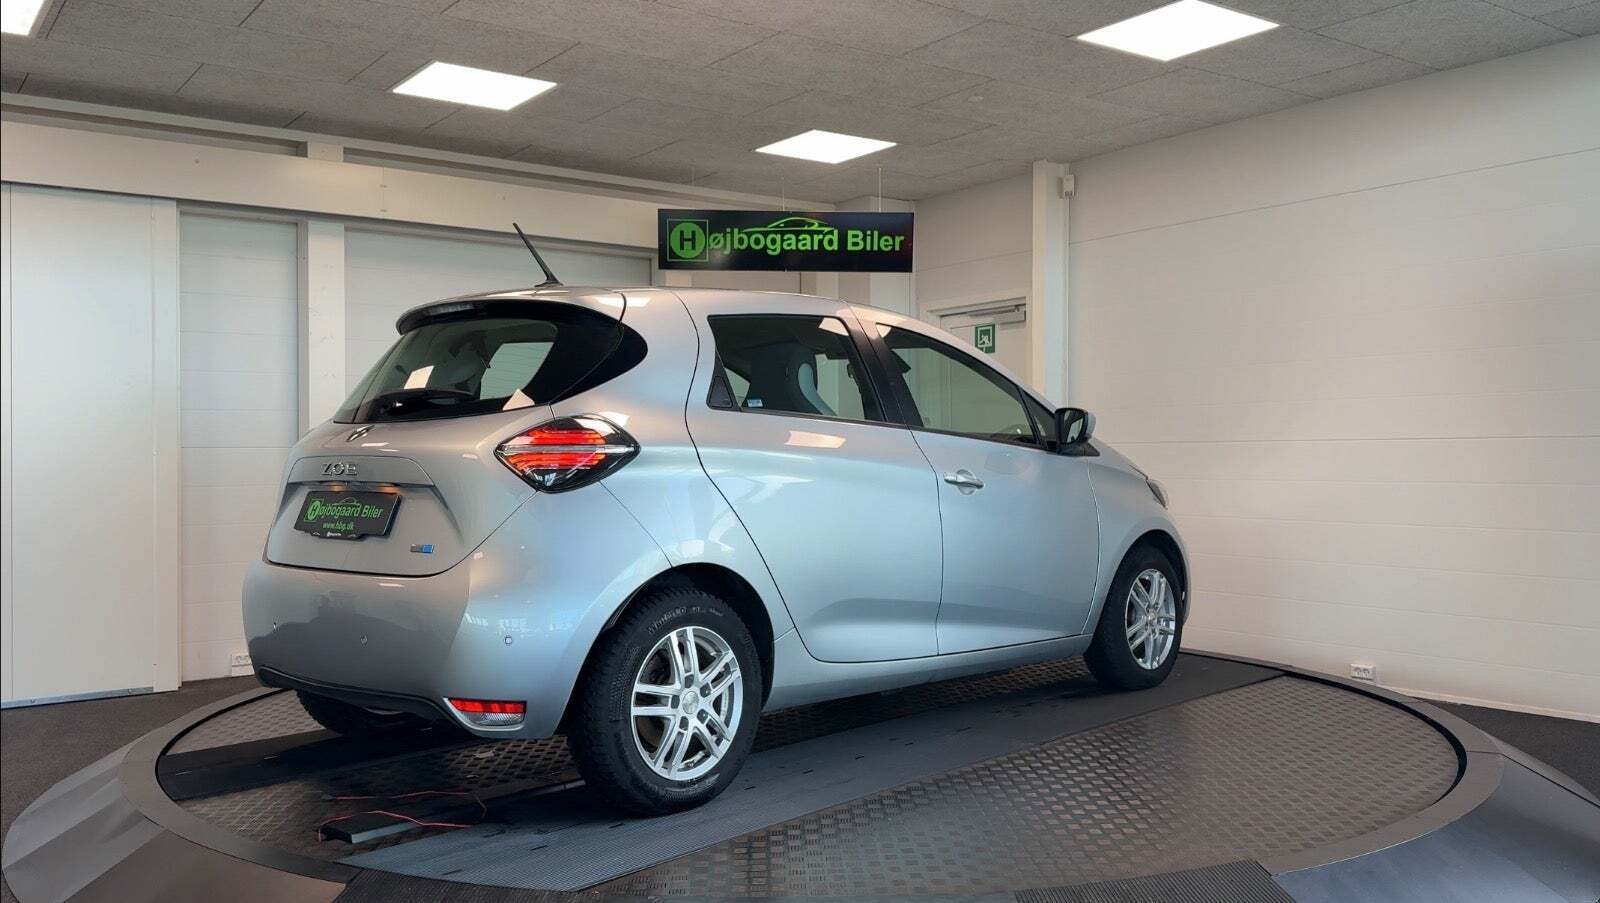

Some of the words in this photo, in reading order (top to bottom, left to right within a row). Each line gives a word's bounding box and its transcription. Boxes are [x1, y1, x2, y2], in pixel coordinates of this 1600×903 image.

[672, 225, 839, 257] Højbogaard
[847, 229, 905, 251] Biler
[361, 505, 384, 519] Biler
